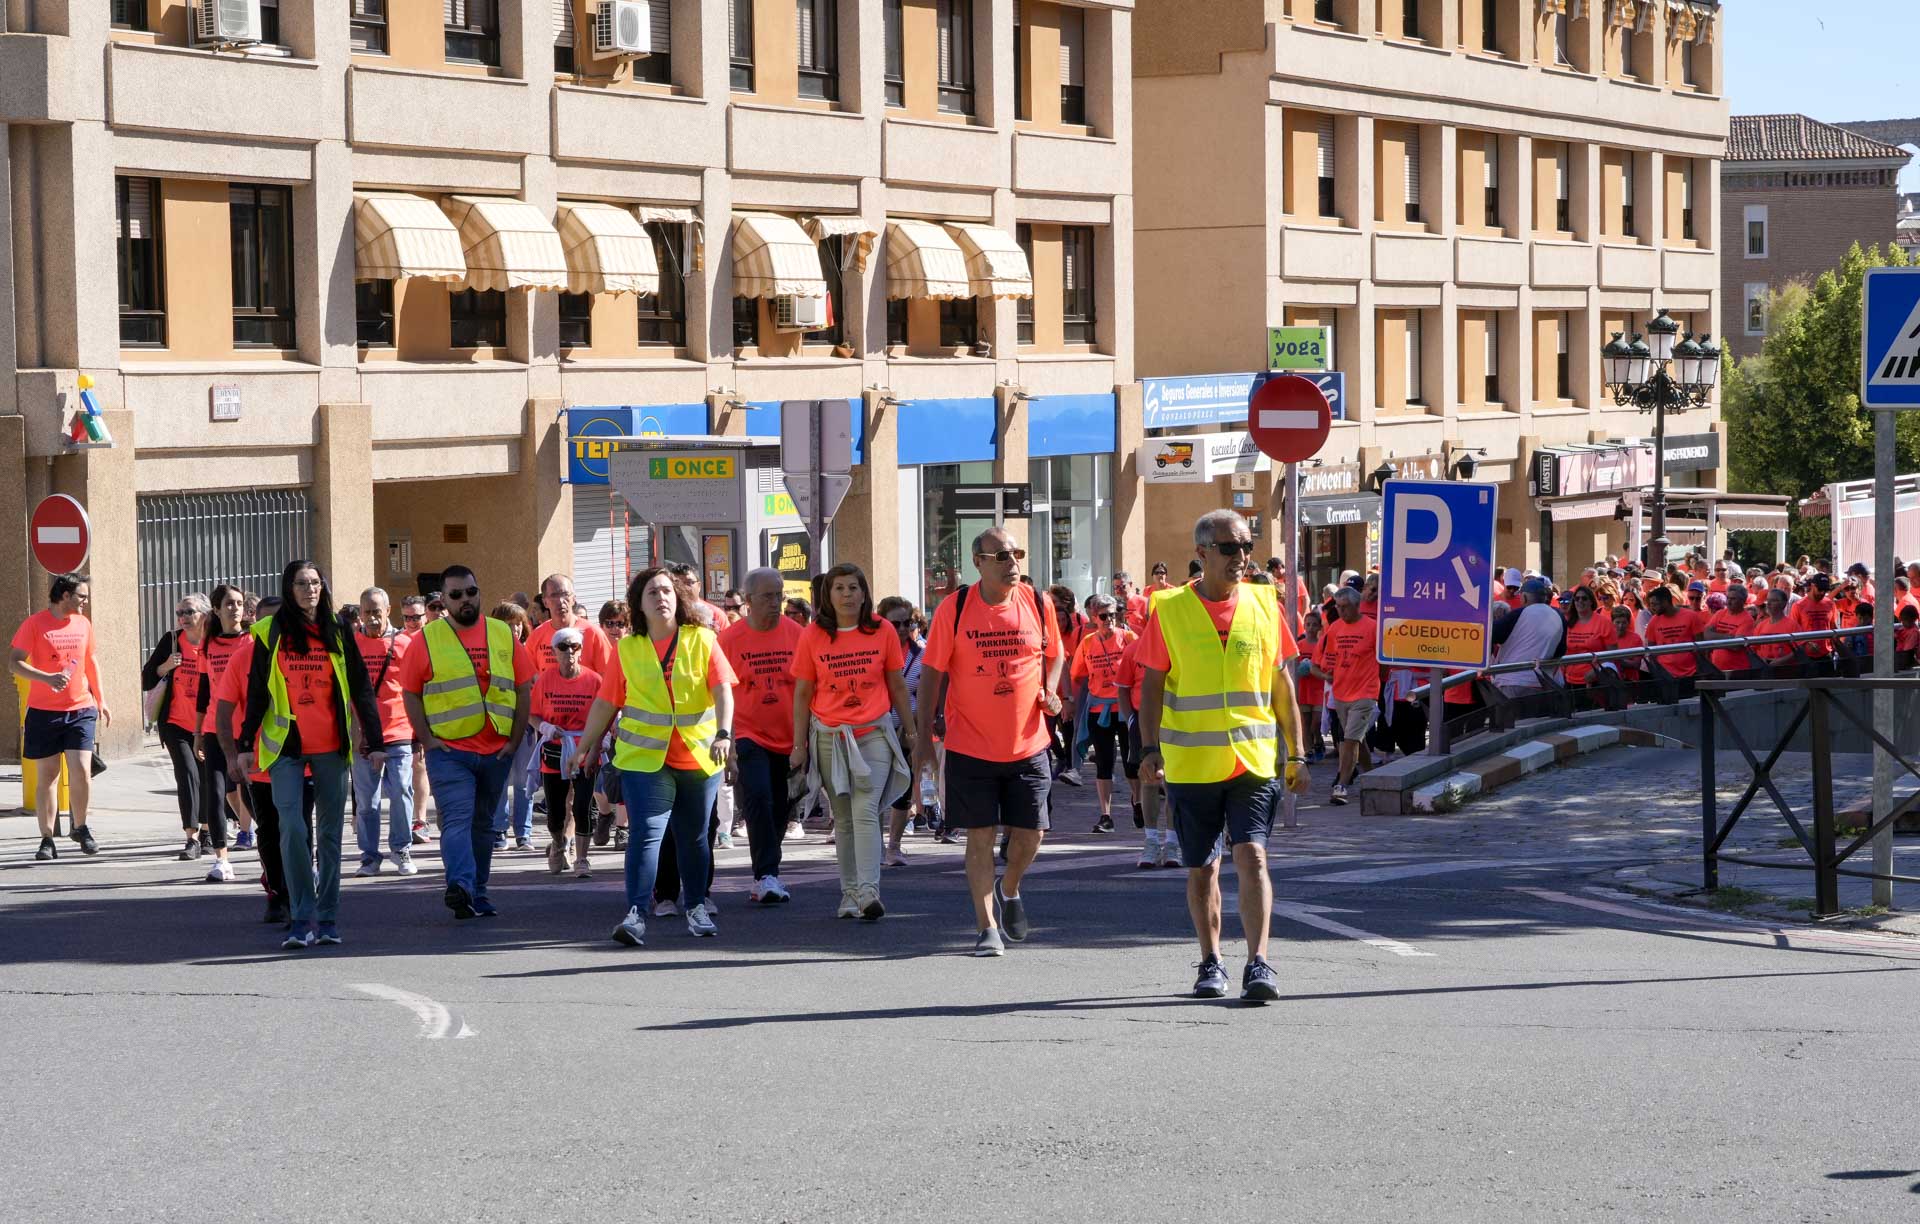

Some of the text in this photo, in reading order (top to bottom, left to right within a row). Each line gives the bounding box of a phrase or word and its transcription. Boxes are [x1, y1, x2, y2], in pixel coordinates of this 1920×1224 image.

[1275, 340, 1320, 356] yoga
[1161, 384, 1185, 405] Seguros
[1185, 382, 1213, 400] Generales
[1219, 380, 1249, 398] Inversiones
[674, 460, 728, 476] ONCE
[1402, 461, 1425, 480] Alba
[1541, 457, 1551, 491] AMSTEL
[779, 497, 794, 512] ON
[1391, 493, 1453, 598] P
[709, 570, 725, 592] 15
[1413, 581, 1446, 600] 24 H
[965, 629, 979, 639] VI
[975, 638, 1026, 649] PARKINSON
[1417, 644, 1450, 655] (Occid.)
[284, 653, 329, 662] PARKINSON
[982, 648, 1019, 658] SEGOVIA
[289, 664, 323, 672] SEGOVIA
[828, 657, 872, 670] PARKINSON
[833, 667, 867, 678] SEGOVIA
